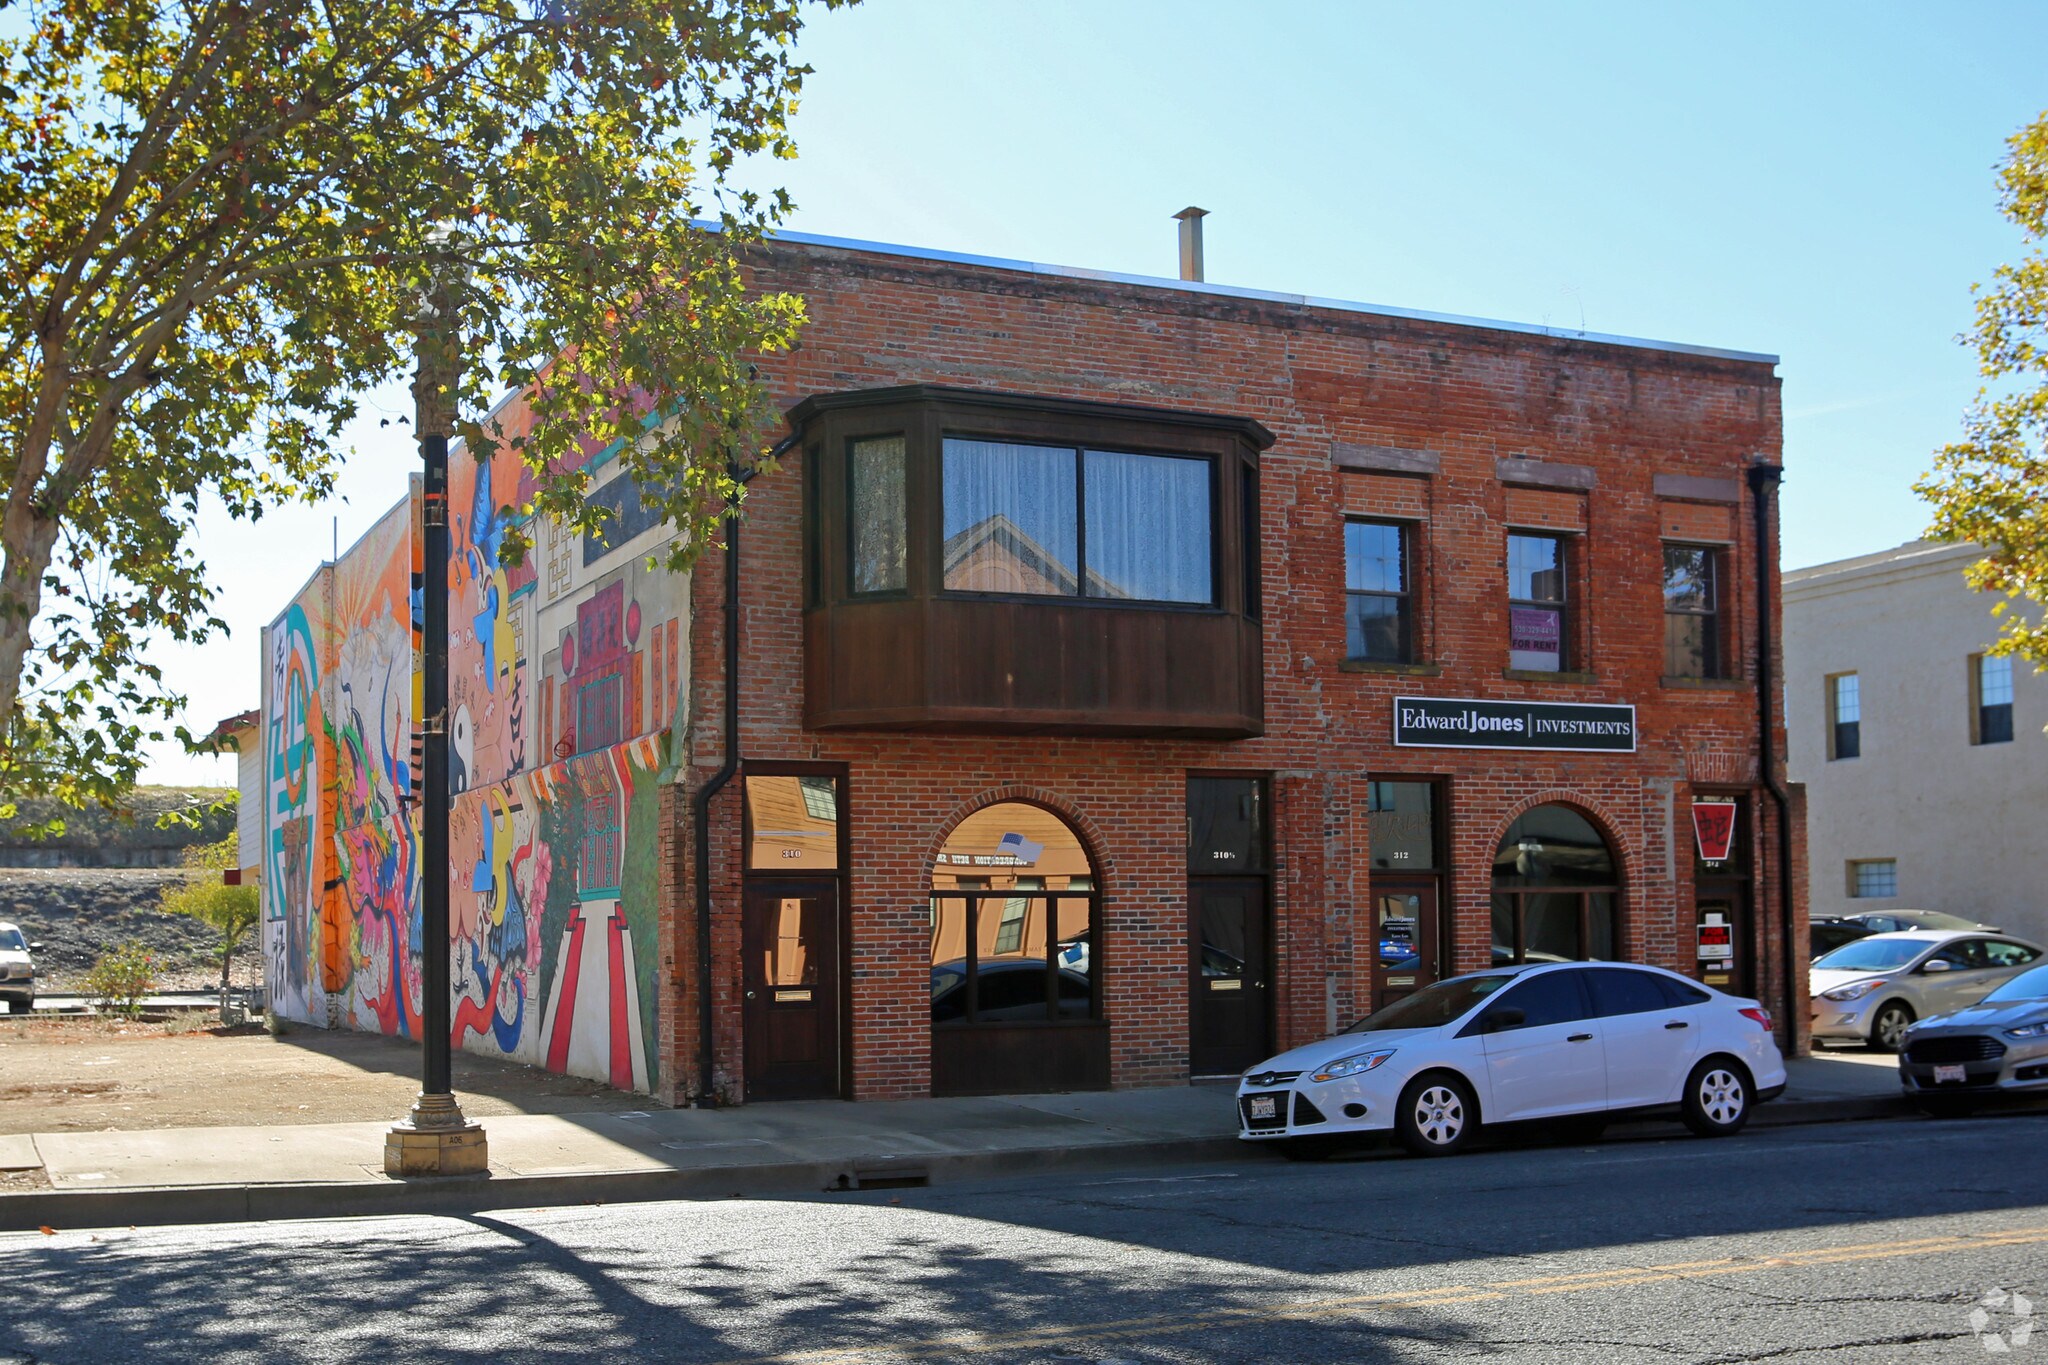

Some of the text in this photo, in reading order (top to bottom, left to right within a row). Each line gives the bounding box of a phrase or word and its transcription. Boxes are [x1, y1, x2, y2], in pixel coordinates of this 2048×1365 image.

[1512, 640, 1558, 650] FOR RENT
[1536, 719, 1631, 735] INVESTMENTS
[781, 849, 802, 859] 310
[1393, 851, 1409, 859] 312
